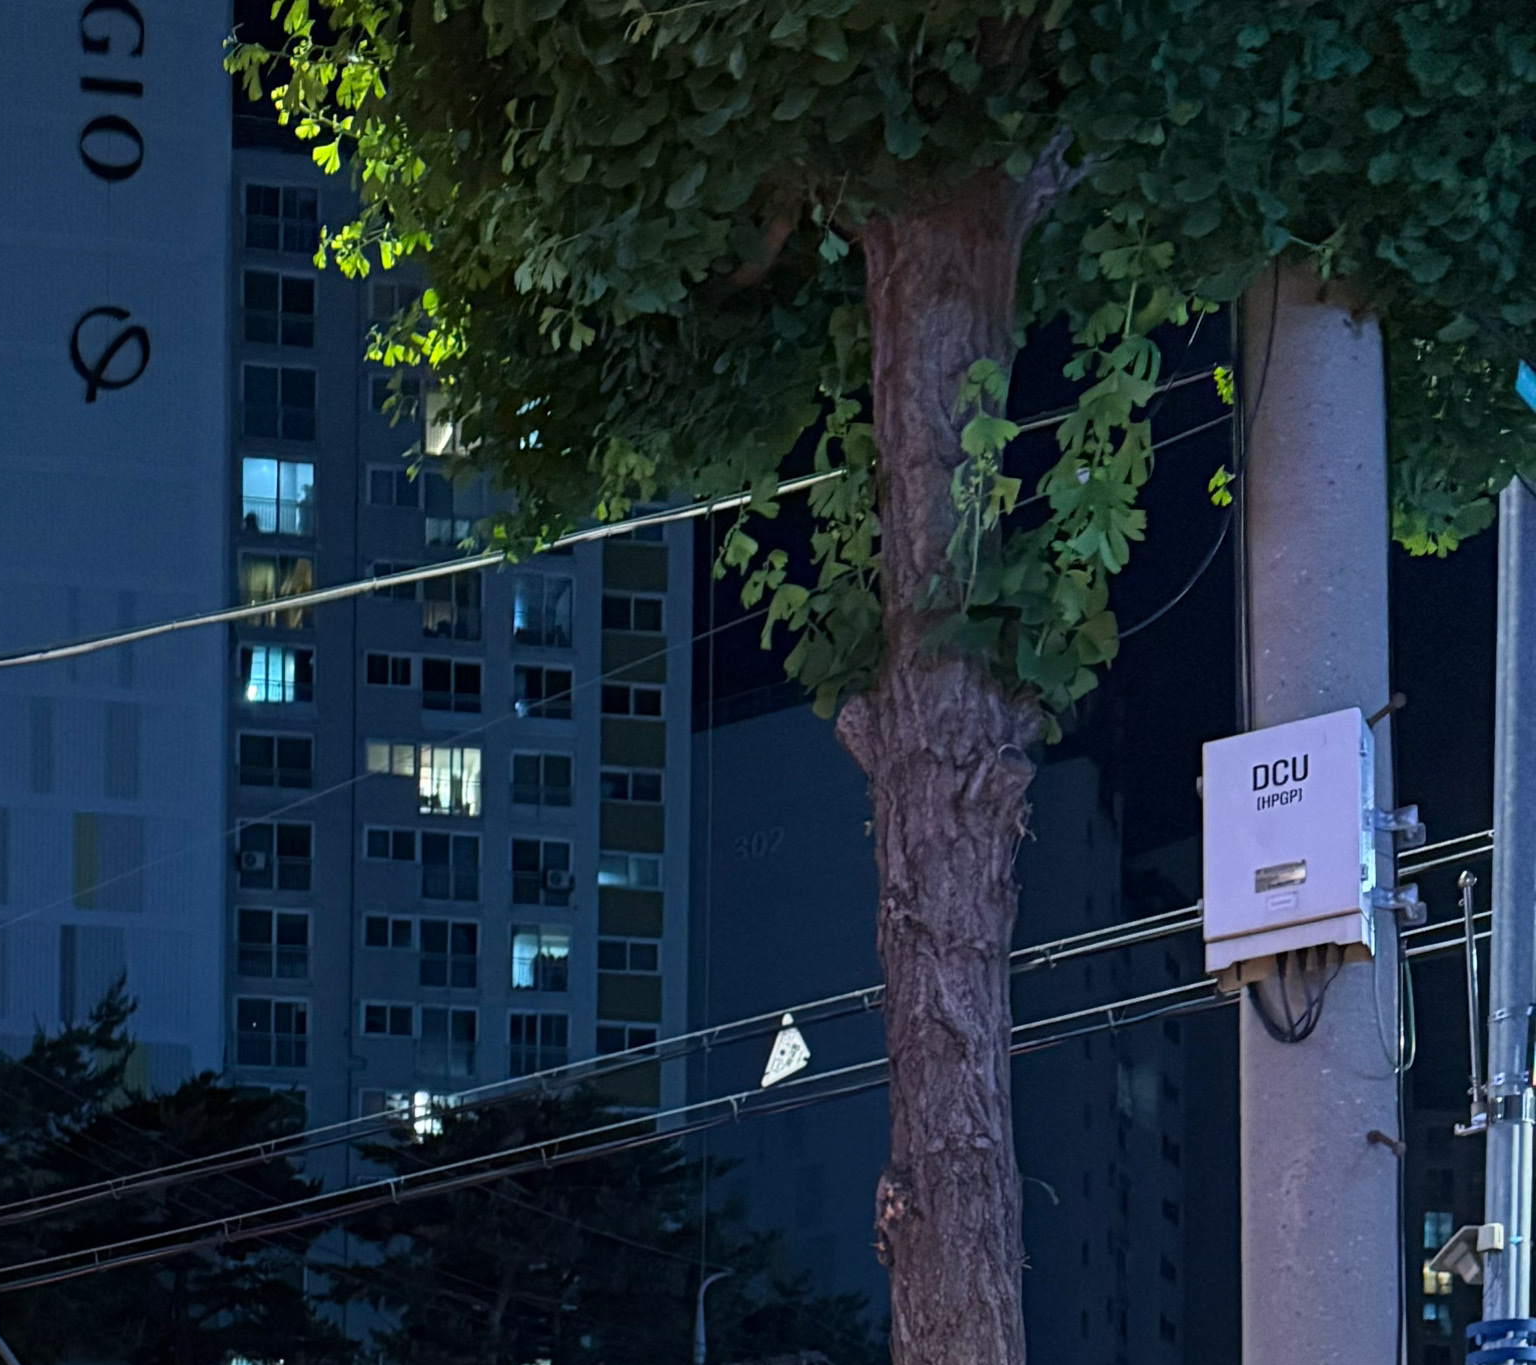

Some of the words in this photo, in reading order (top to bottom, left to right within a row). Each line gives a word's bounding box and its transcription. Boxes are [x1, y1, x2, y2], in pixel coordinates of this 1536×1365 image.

[78, 0, 145, 182] GIO
[1252, 754, 1309, 792] DCU
[734, 826, 785, 861] 302
